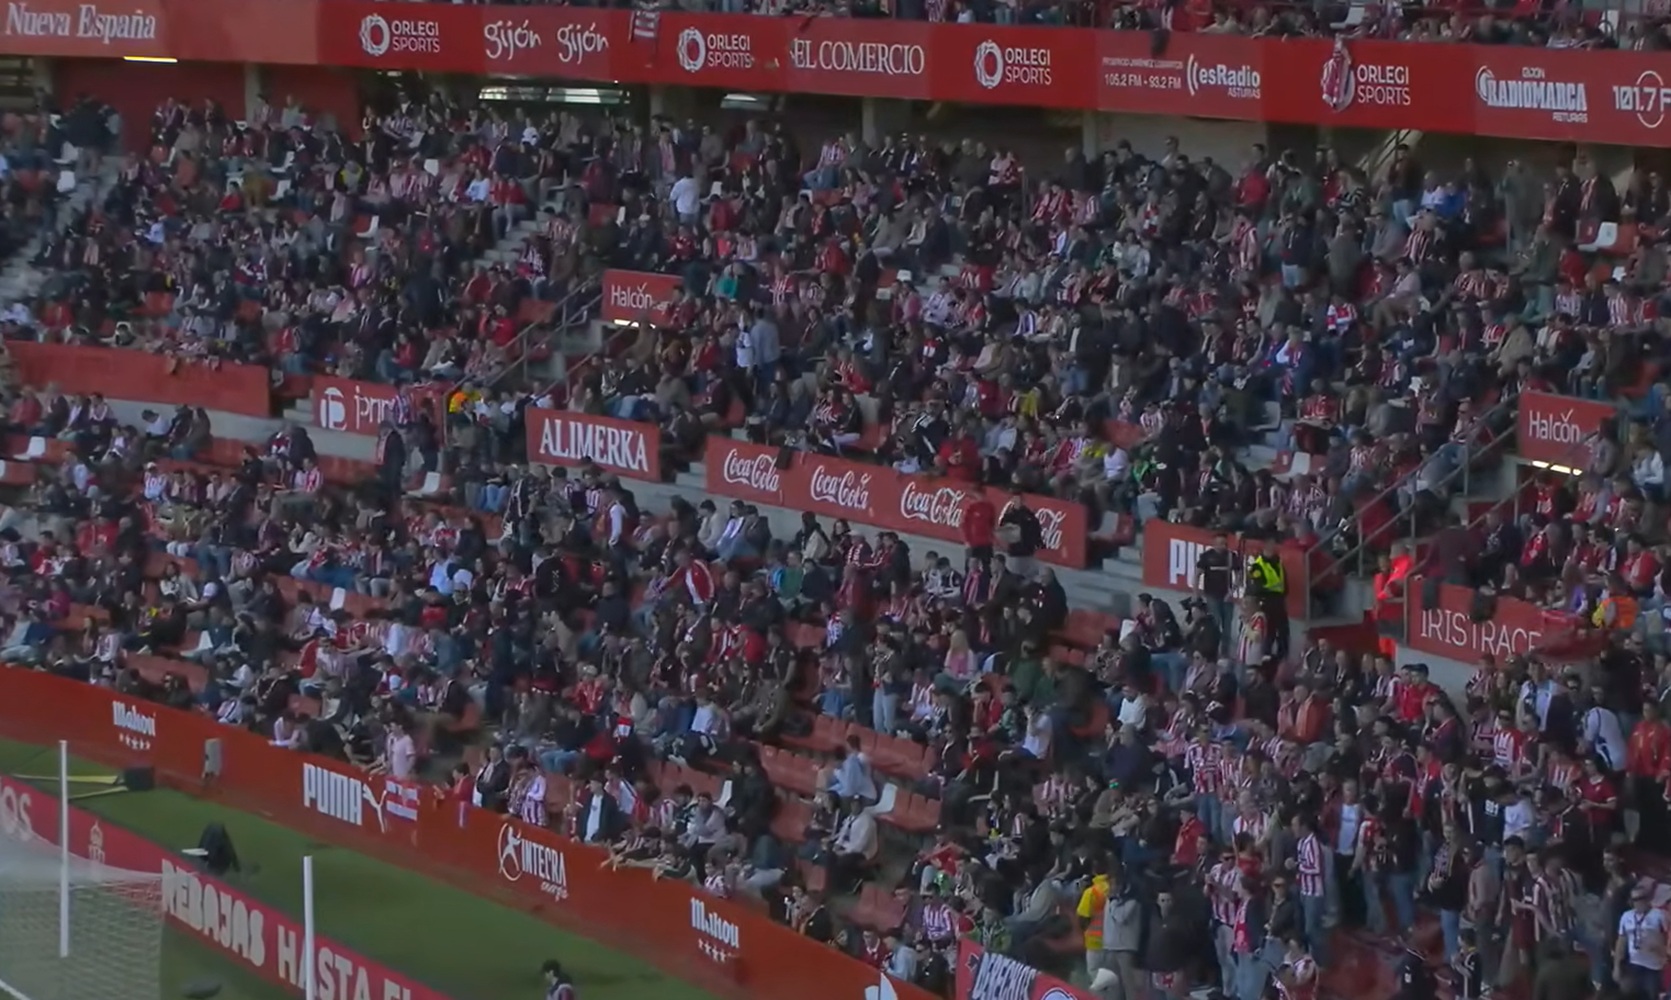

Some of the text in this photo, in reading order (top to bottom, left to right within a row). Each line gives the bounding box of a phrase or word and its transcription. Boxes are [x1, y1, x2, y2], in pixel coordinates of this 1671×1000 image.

[5, 2, 156, 45] Nueva España
[391, 20, 439, 36] ORLEGI
[392, 36, 440, 53] SPORTS
[707, 34, 751, 50] ORLEGI
[707, 52, 752, 69] SPORTS
[794, 38, 925, 75] EL COMERCIO
[1005, 47, 1051, 66] ORLEGI
[1005, 66, 1052, 85] SPORTS
[1128, 74, 1142, 87] FM
[1168, 76, 1182, 89] FM
[1199, 64, 1261, 88] esRadio
[1357, 64, 1409, 84] ORLEGI
[1357, 85, 1411, 105] SPORTS
[1487, 79, 1587, 111] RADIOMARCA
[1612, 85, 1657, 111] 101.7
[611, 282, 653, 309] Halcón
[1528, 408, 1580, 443] Halcón
[539, 418, 648, 472] ALIMERKA
[303, 762, 363, 826] PUMA
[161, 859, 266, 967] REBAJAS
